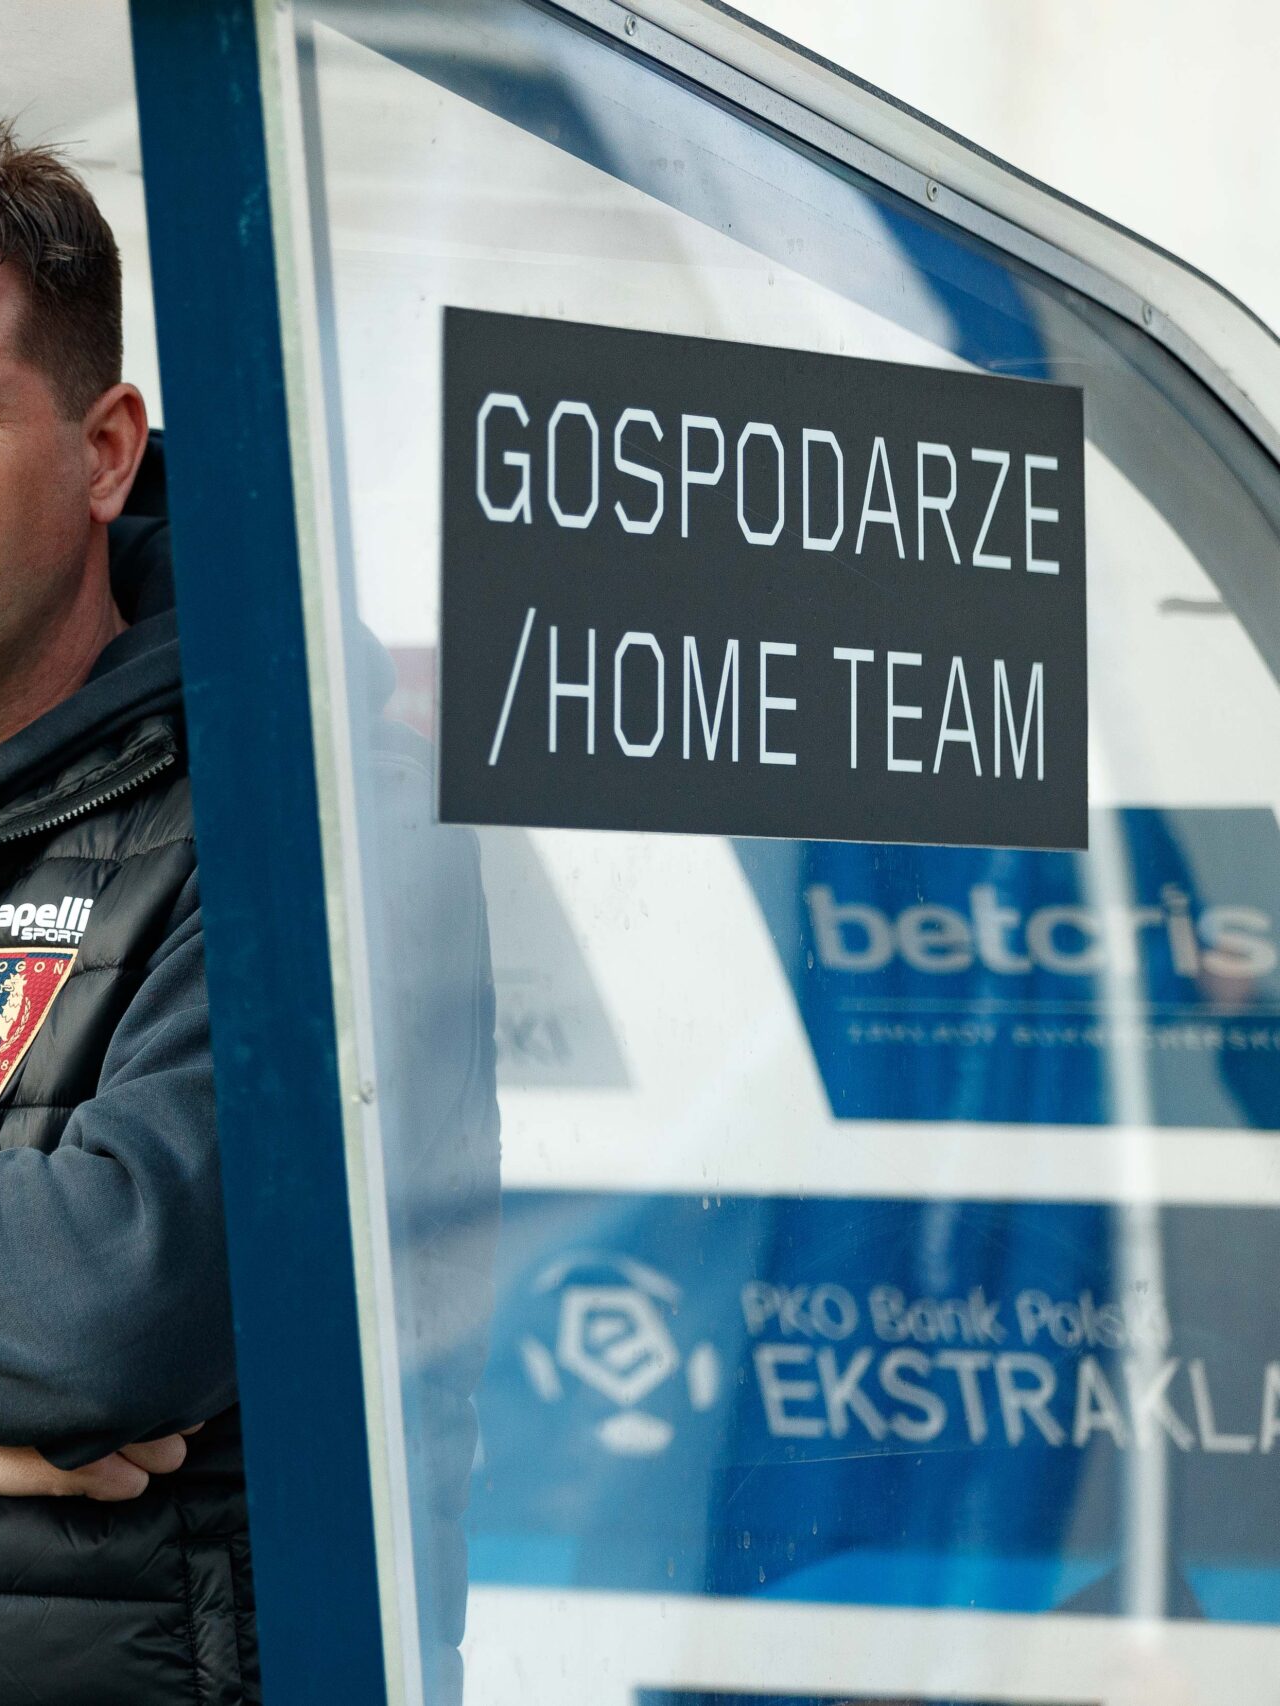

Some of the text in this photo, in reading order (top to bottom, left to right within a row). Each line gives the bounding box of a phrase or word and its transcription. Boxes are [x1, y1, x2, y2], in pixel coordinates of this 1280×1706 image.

[476, 391, 1061, 576] GOSPODARZE
[488, 606, 1045, 781] /HOME TEAM
[21, 927, 84, 945] SPORT
[740, 1280, 859, 1341] PKO
[868, 1283, 1006, 1345] Bank
